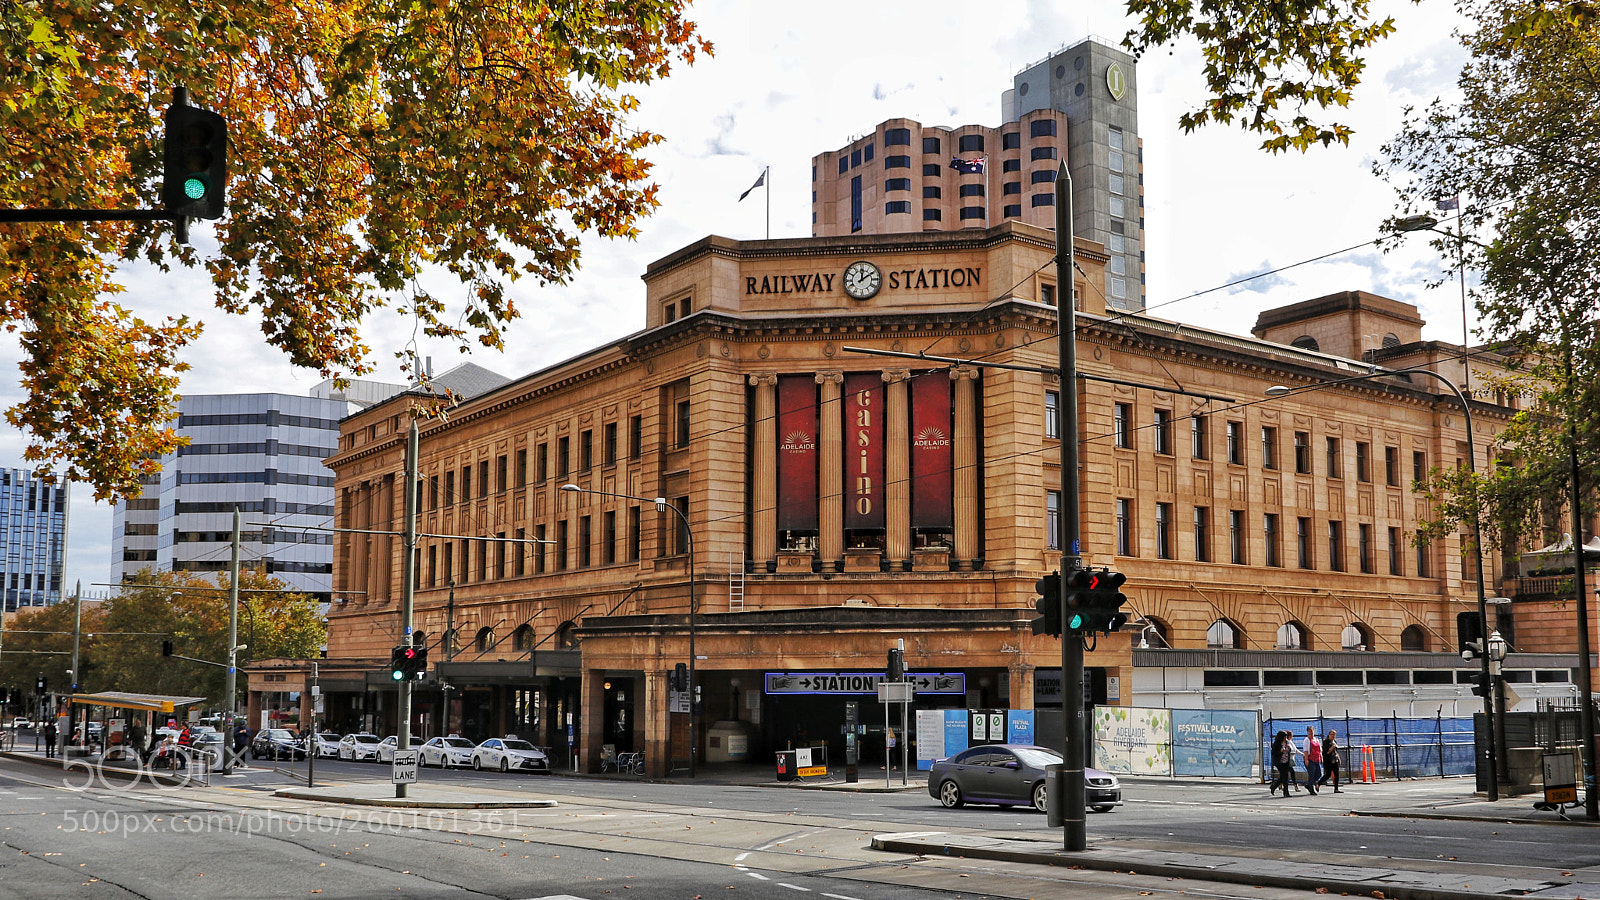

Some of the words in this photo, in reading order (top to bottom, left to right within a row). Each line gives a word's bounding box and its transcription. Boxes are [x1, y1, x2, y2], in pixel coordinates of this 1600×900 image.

[746, 272, 836, 295] RAILWAY
[889, 267, 981, 289] STATION
[856, 389, 871, 515] casino
[813, 676, 874, 691] STATION
[1037, 678, 1060, 687] STATION
[1041, 687, 1056, 695] LANE
[1116, 727, 1146, 738] ADELAIDE
[1177, 724, 1210, 734] FESTIVAL
[1211, 725, 1236, 734] PLAZA
[1113, 737, 1148, 749] RIVERBANK
[394, 771, 415, 780] LANE
